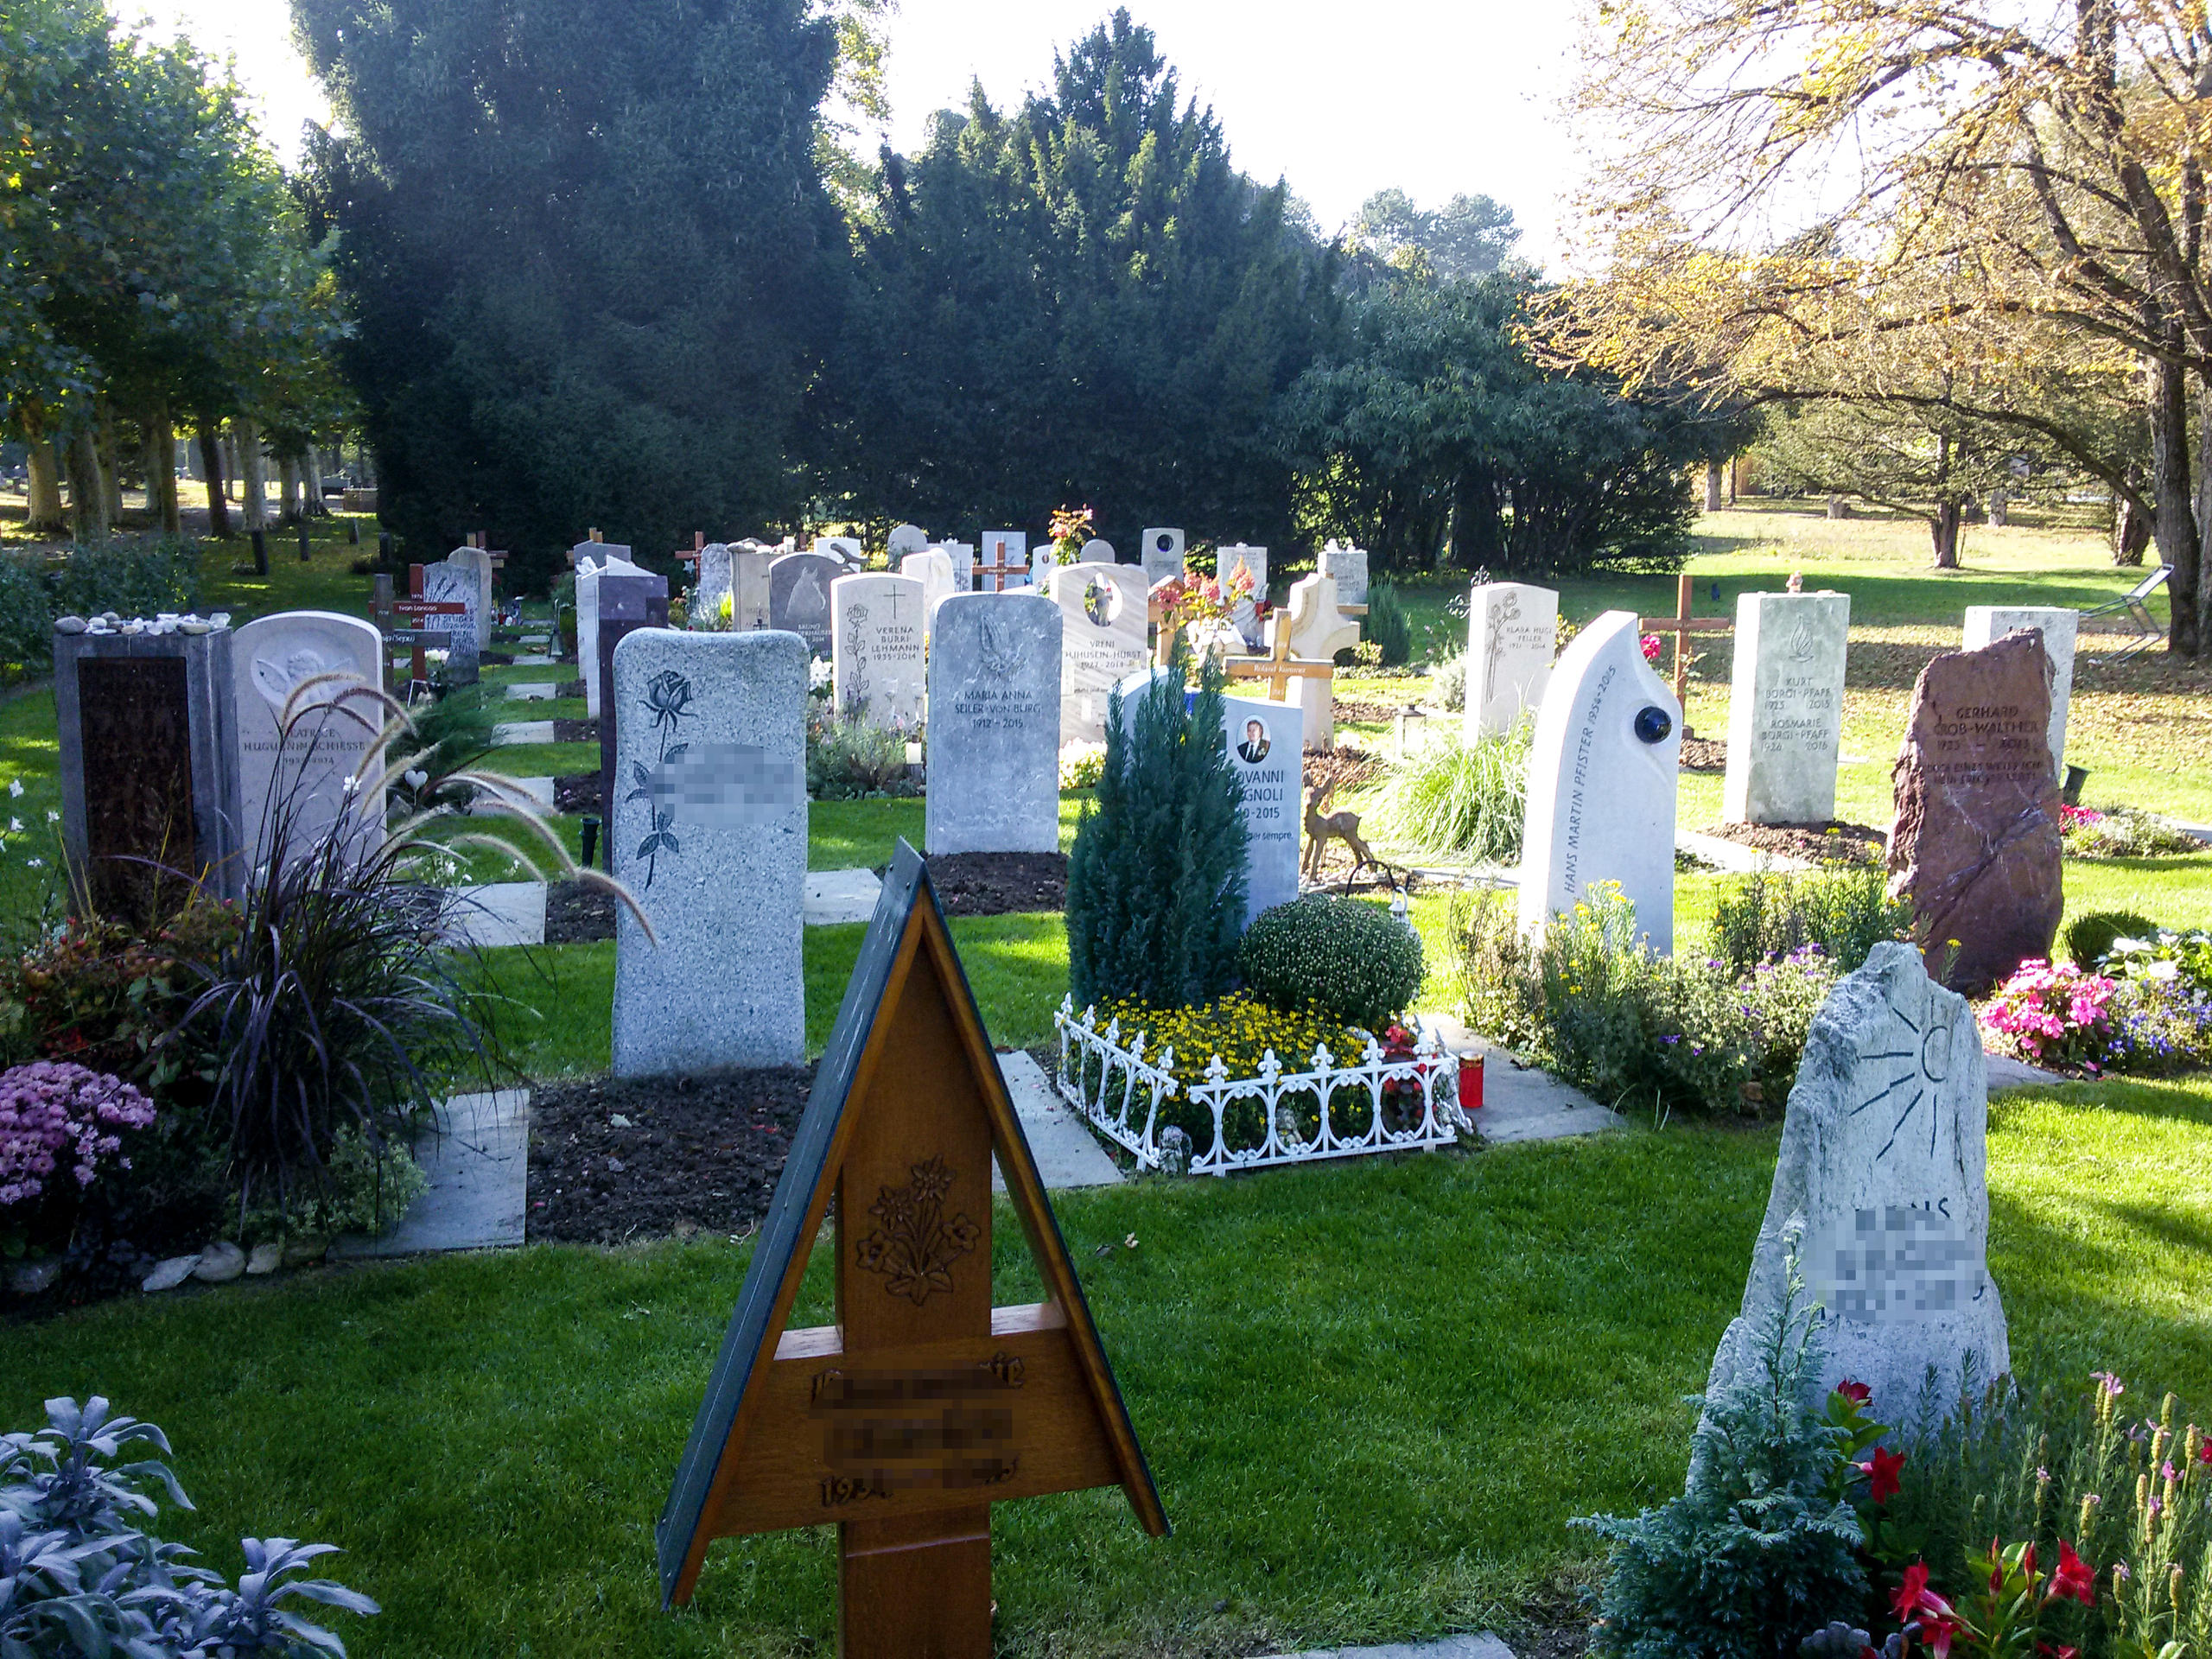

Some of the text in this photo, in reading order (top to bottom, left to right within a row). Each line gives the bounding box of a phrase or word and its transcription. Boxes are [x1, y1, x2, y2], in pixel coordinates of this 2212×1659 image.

[1785, 677, 1814, 686] KURT
[963, 690, 1033, 701] MARIA ANNA
[1014, 703, 1040, 714] BURG
[1956, 705, 2018, 719] GERHARD
[973, 719, 992, 728] 1912
[1002, 718, 1024, 728] 2015
[1770, 718, 1821, 729] ROSMARIE
[1573, 727, 1593, 787] PFISTER
[1567, 789, 1583, 849] MARTIN
[1564, 852, 1578, 893] HANS
